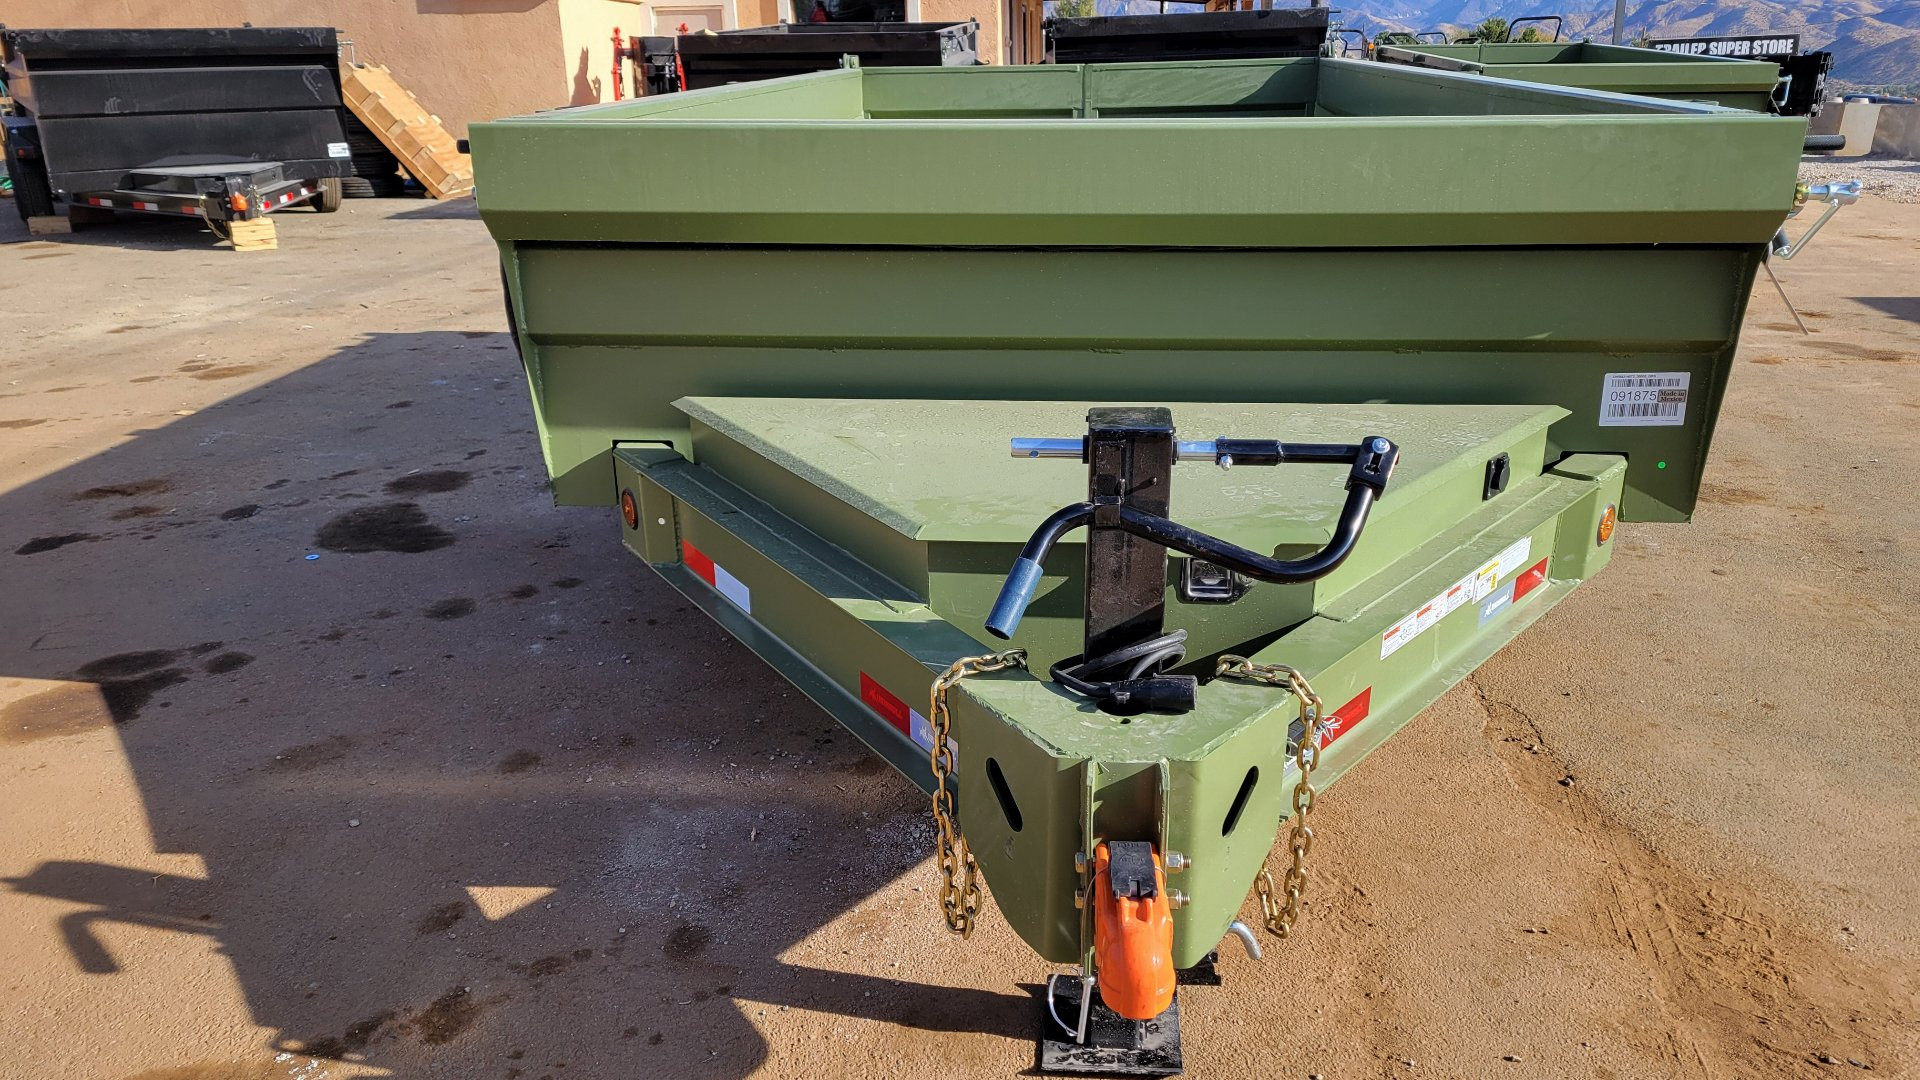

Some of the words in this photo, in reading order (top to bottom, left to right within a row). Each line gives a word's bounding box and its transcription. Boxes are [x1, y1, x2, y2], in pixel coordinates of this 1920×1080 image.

[1709, 40, 1751, 55] SUPER
[1753, 39, 1795, 54] STORE
[1610, 390, 1657, 402] 091875
